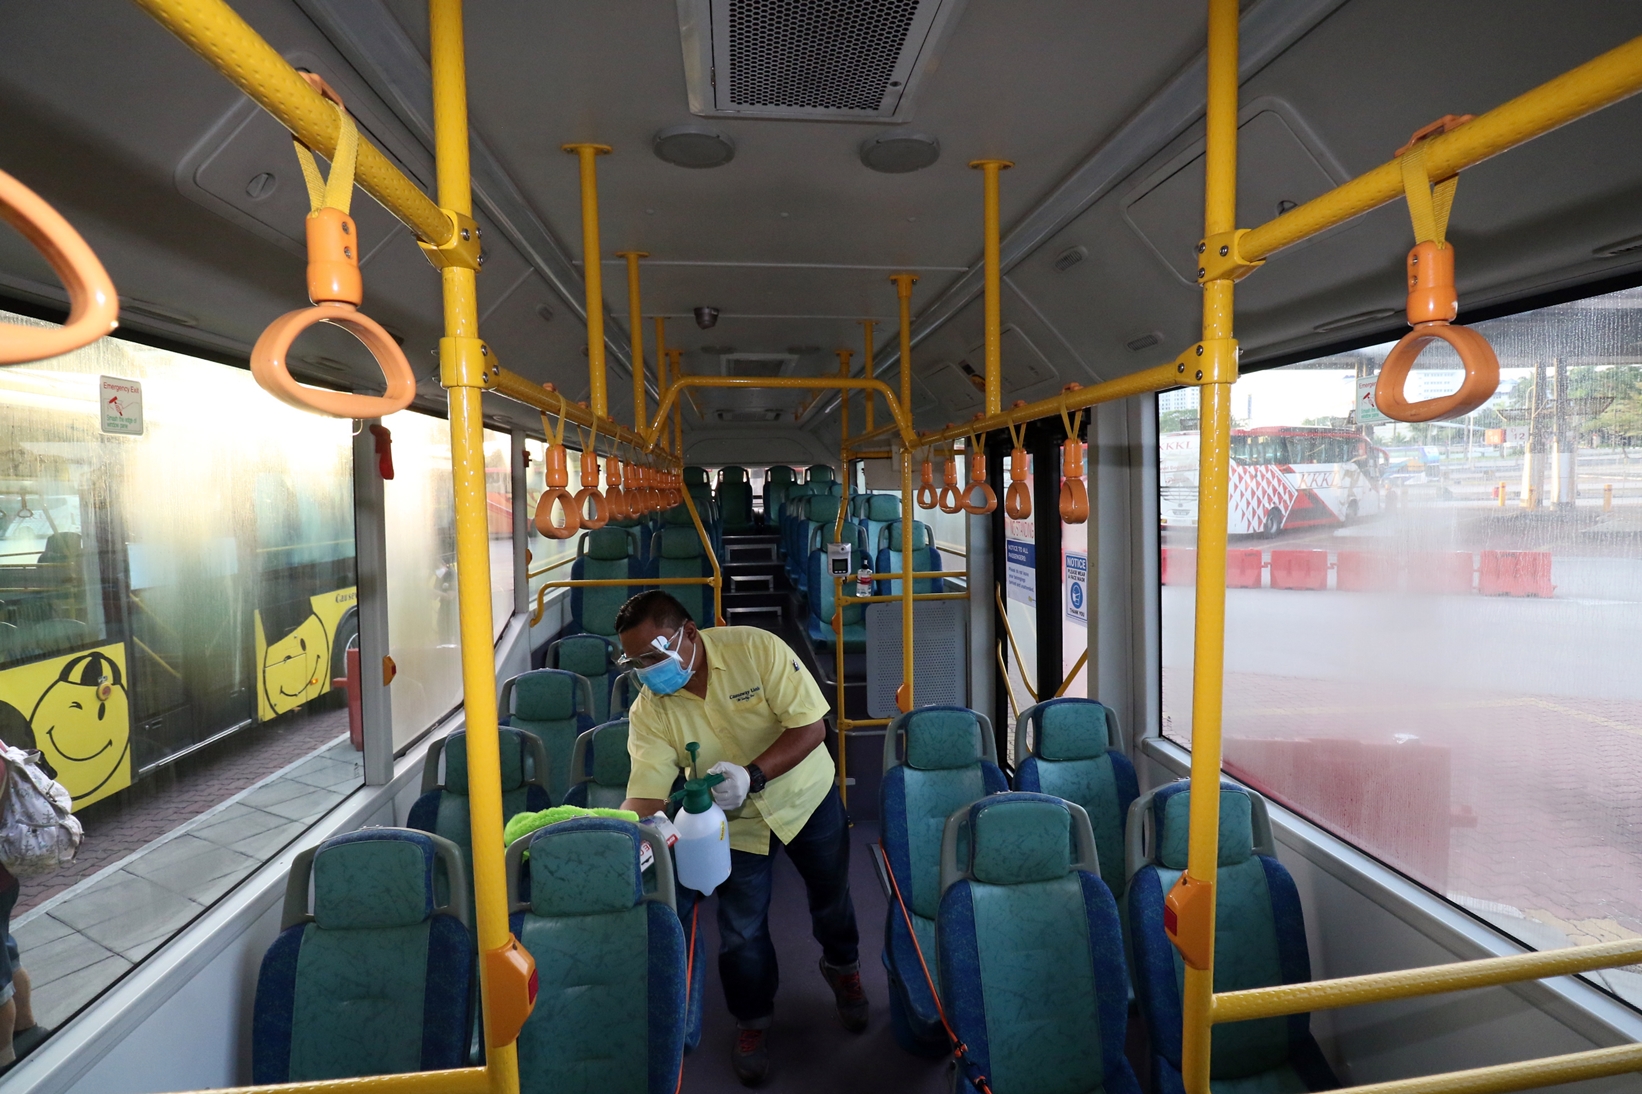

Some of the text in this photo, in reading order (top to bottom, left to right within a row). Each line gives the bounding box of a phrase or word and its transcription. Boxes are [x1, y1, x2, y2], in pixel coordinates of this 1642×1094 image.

[103, 382, 139, 394] Emergency Exit
[1300, 472, 1341, 487] KKKL
[1067, 558, 1086, 569] NOTICE
[335, 592, 357, 603] Cause
[730, 690, 750, 699] Causeway
